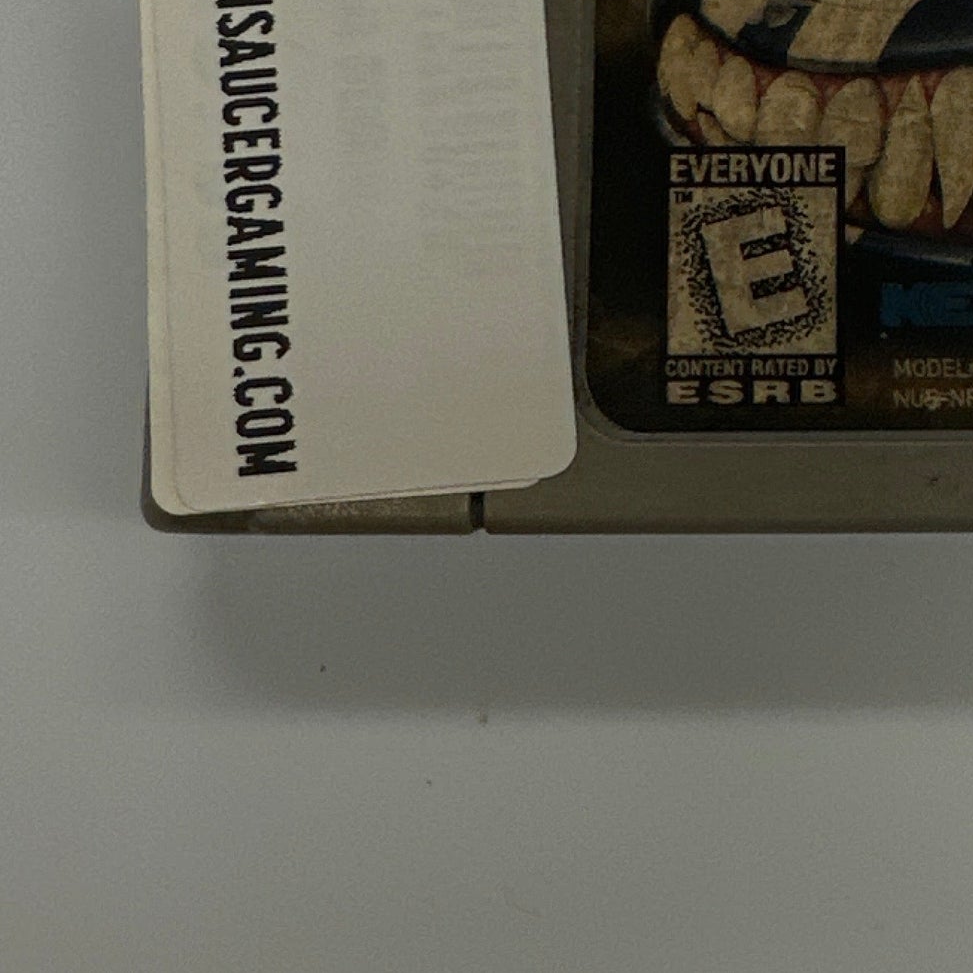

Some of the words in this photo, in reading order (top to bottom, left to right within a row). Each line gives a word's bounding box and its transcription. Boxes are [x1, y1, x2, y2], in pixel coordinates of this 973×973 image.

[669, 153, 837, 183] EVERYONE
[665, 358, 744, 377] CONTENT
[752, 358, 808, 377] RATED
[815, 358, 837, 377] BY
[666, 380, 837, 404] ESRB
